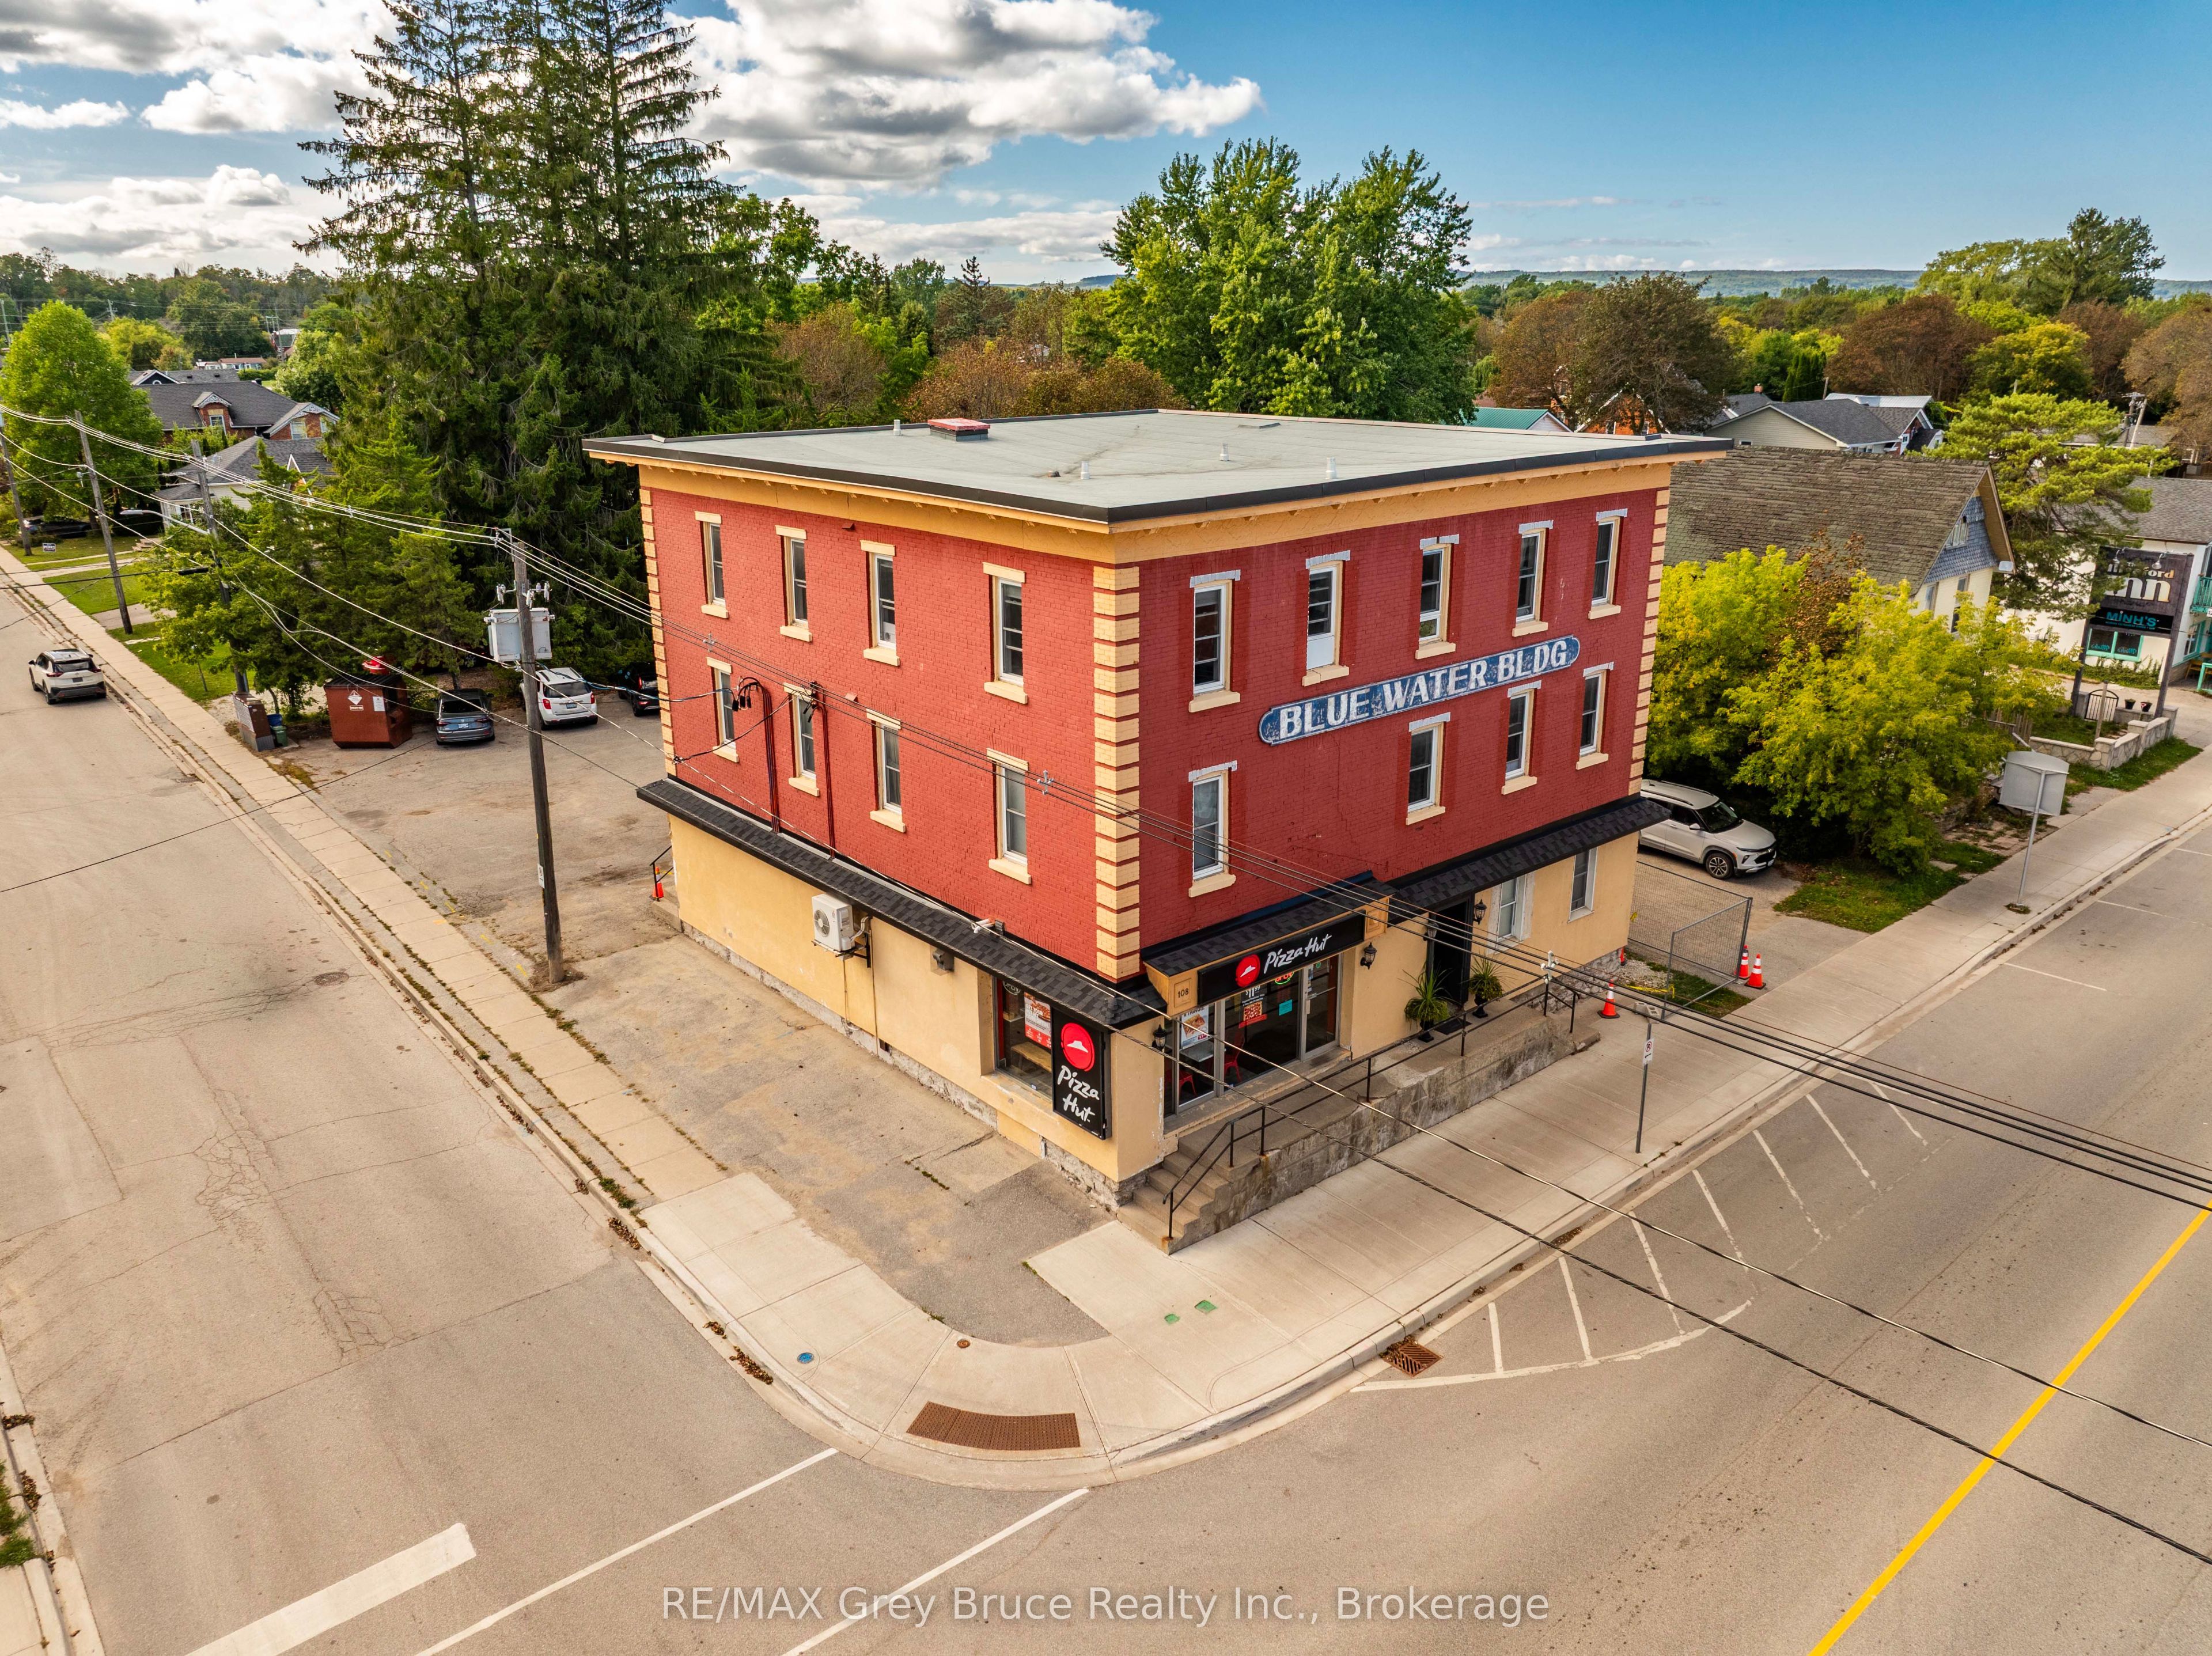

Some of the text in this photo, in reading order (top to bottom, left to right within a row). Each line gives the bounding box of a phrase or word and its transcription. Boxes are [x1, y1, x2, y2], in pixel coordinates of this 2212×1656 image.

[1279, 640, 1567, 740] BLUE WATER BLDG
[1263, 934, 1332, 974] Pizza Hut
[1177, 988, 1189, 998] 108
[1057, 1065, 1100, 1100] Pizza
[1062, 1093, 1095, 1122] Hut
